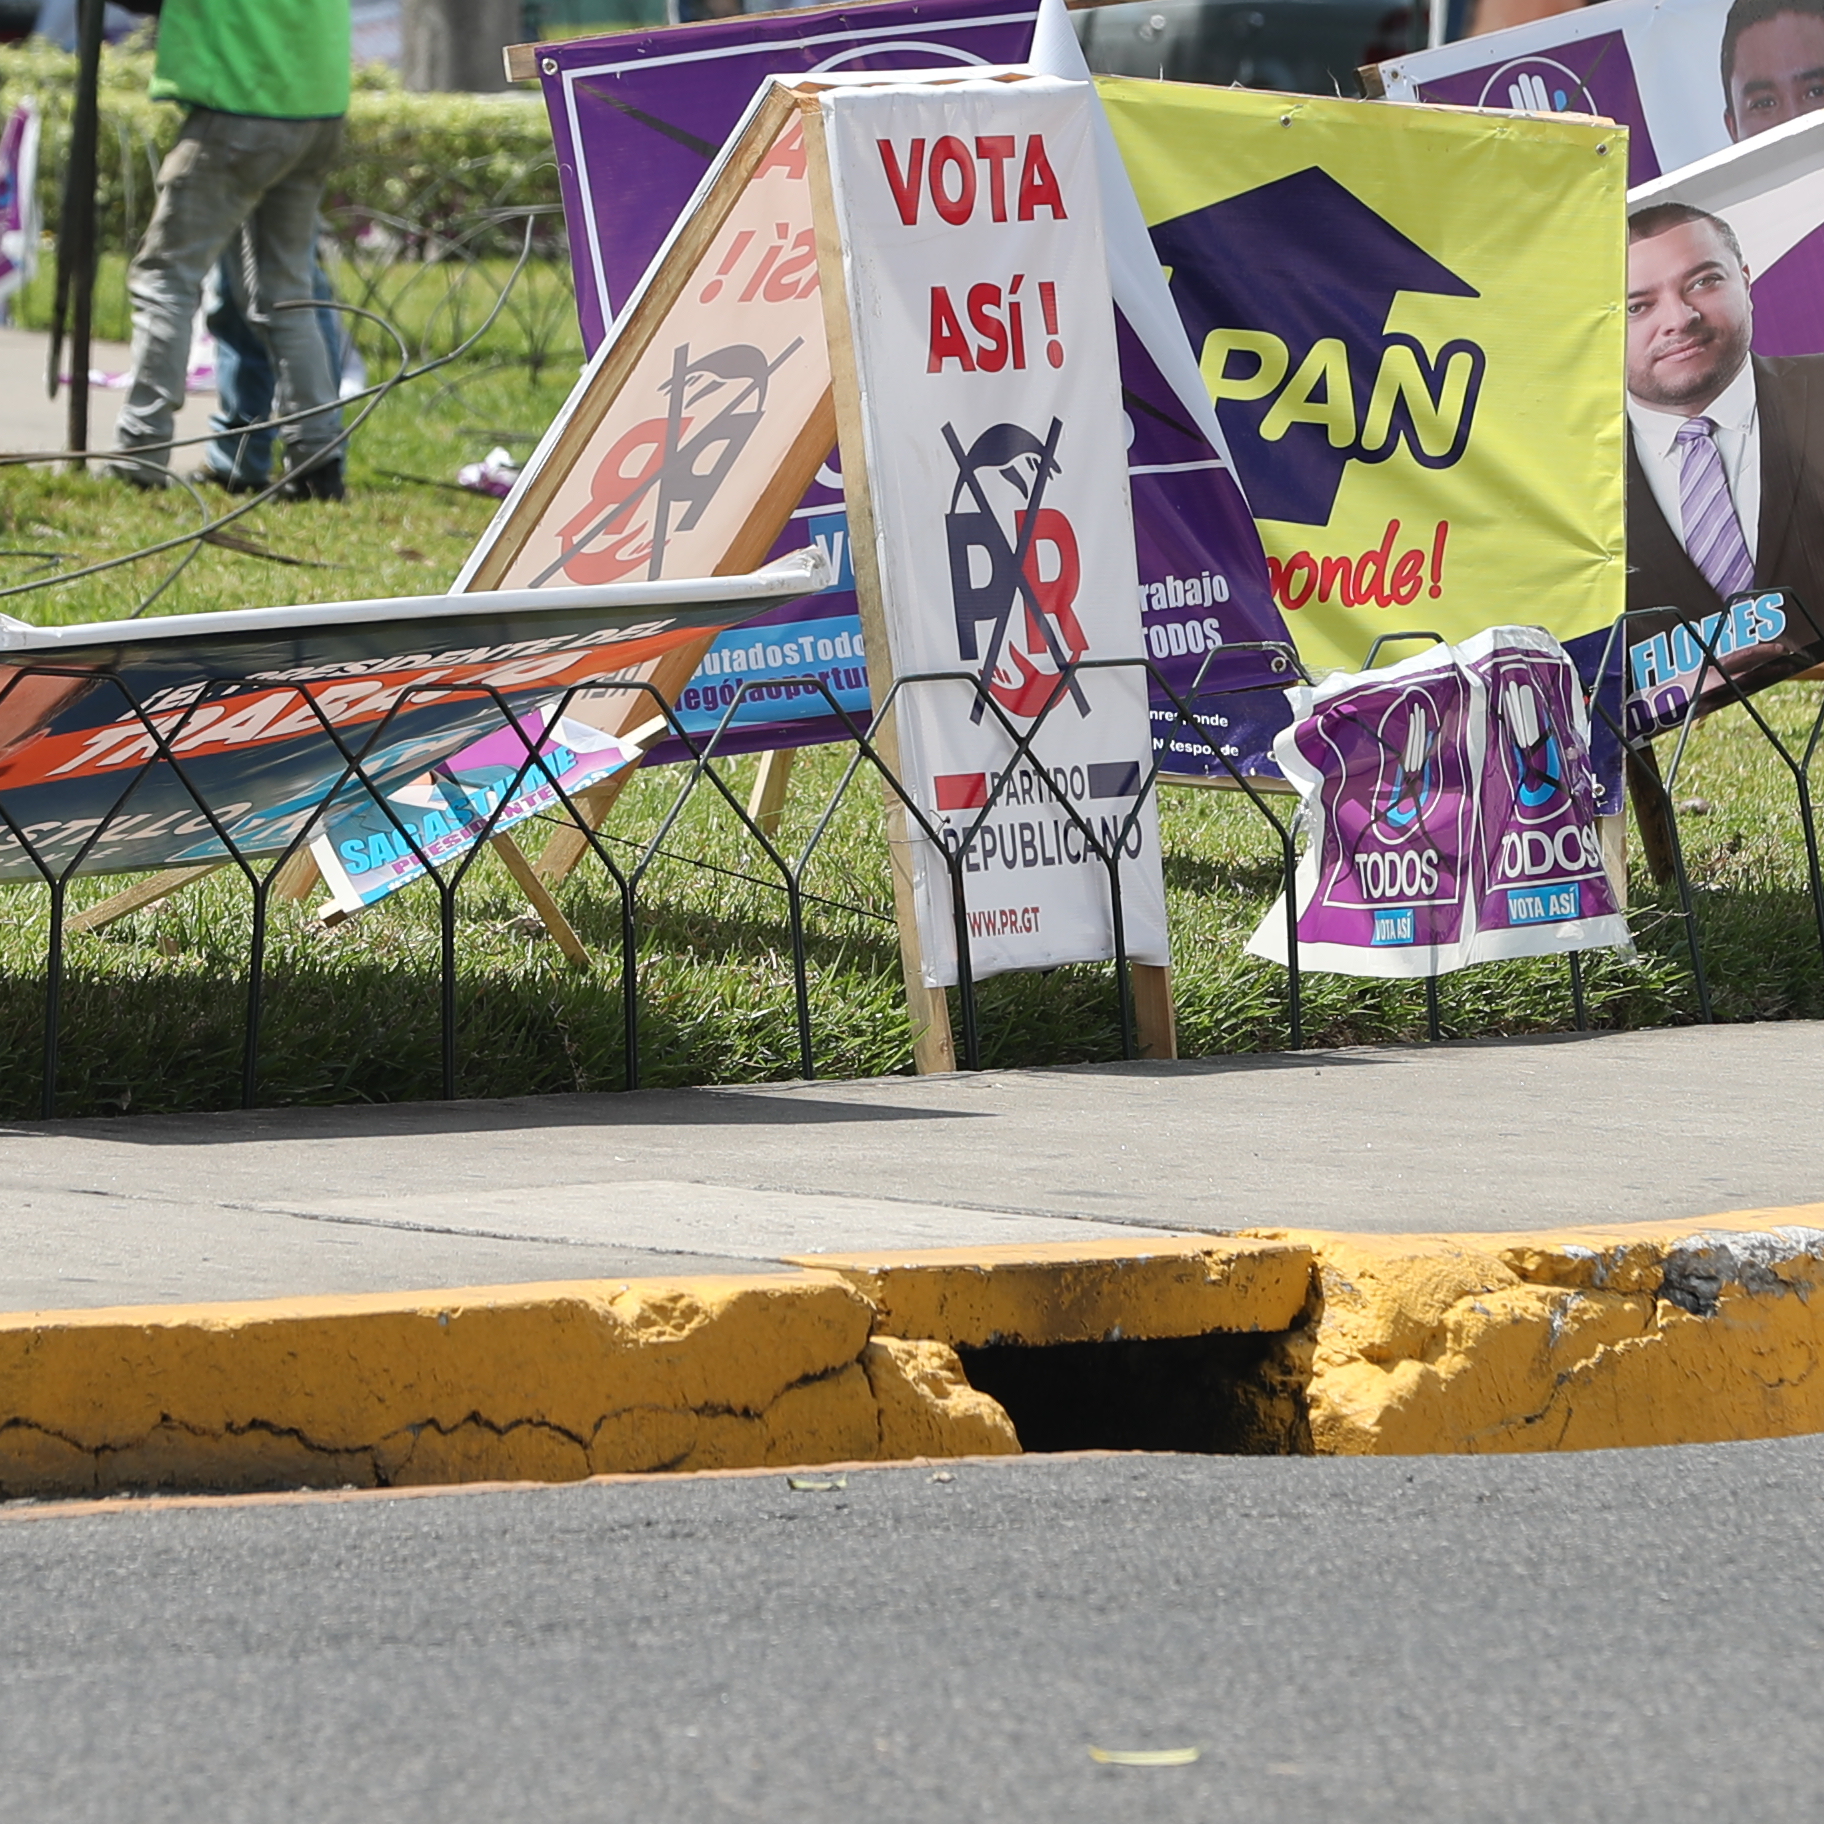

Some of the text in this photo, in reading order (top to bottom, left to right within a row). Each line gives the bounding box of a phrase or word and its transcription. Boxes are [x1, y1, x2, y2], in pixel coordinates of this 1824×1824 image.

[876, 133, 1068, 225] VOTA
[1197, 327, 1476, 459] PAN
[1139, 570, 1230, 613] rabajo
[1264, 519, 1448, 611] onde!
[1629, 592, 1787, 693] FLORES
[46, 649, 593, 776] TRABAJO
[1354, 848, 1439, 900] TODOS
[1496, 821, 1603, 880] TODOS
[954, 906, 1040, 939] WW.PR.GT
[1508, 886, 1576, 920] VOTA ASÍ
